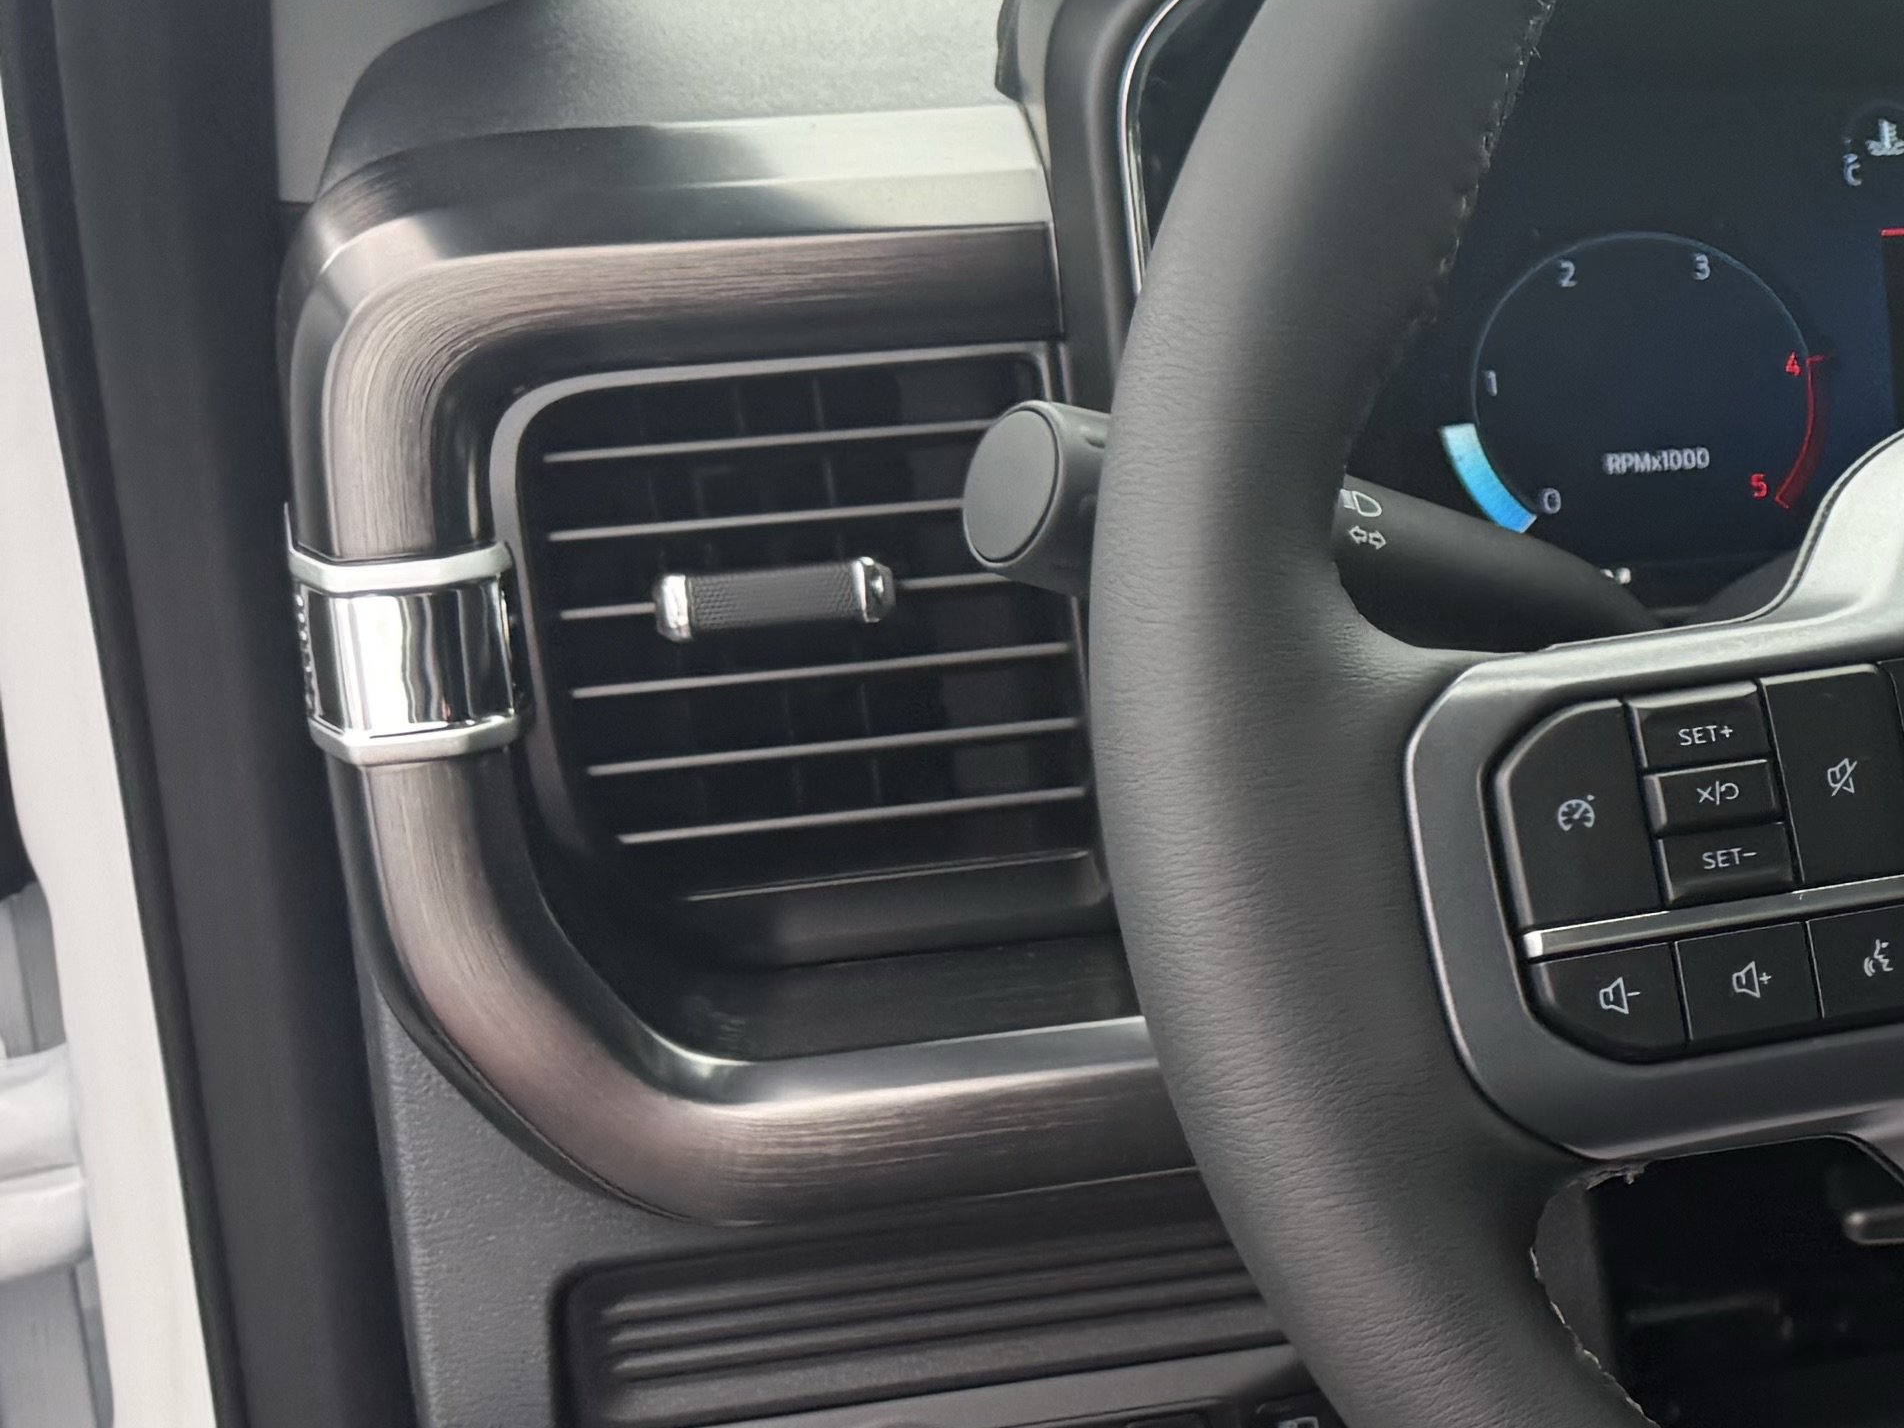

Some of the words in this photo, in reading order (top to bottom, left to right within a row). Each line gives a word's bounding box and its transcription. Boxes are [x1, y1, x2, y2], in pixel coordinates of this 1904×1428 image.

[1560, 260, 1577, 288] 2
[1693, 253, 1712, 281] 3
[1785, 351, 1801, 376] 4
[1487, 369, 1498, 397] 1
[1602, 447, 1711, 475] RPMx1000
[1750, 473, 1768, 499] 5
[1538, 488, 1562, 515] 0
[1678, 725, 1734, 746] SET+
[1701, 848, 1758, 870] SET-
